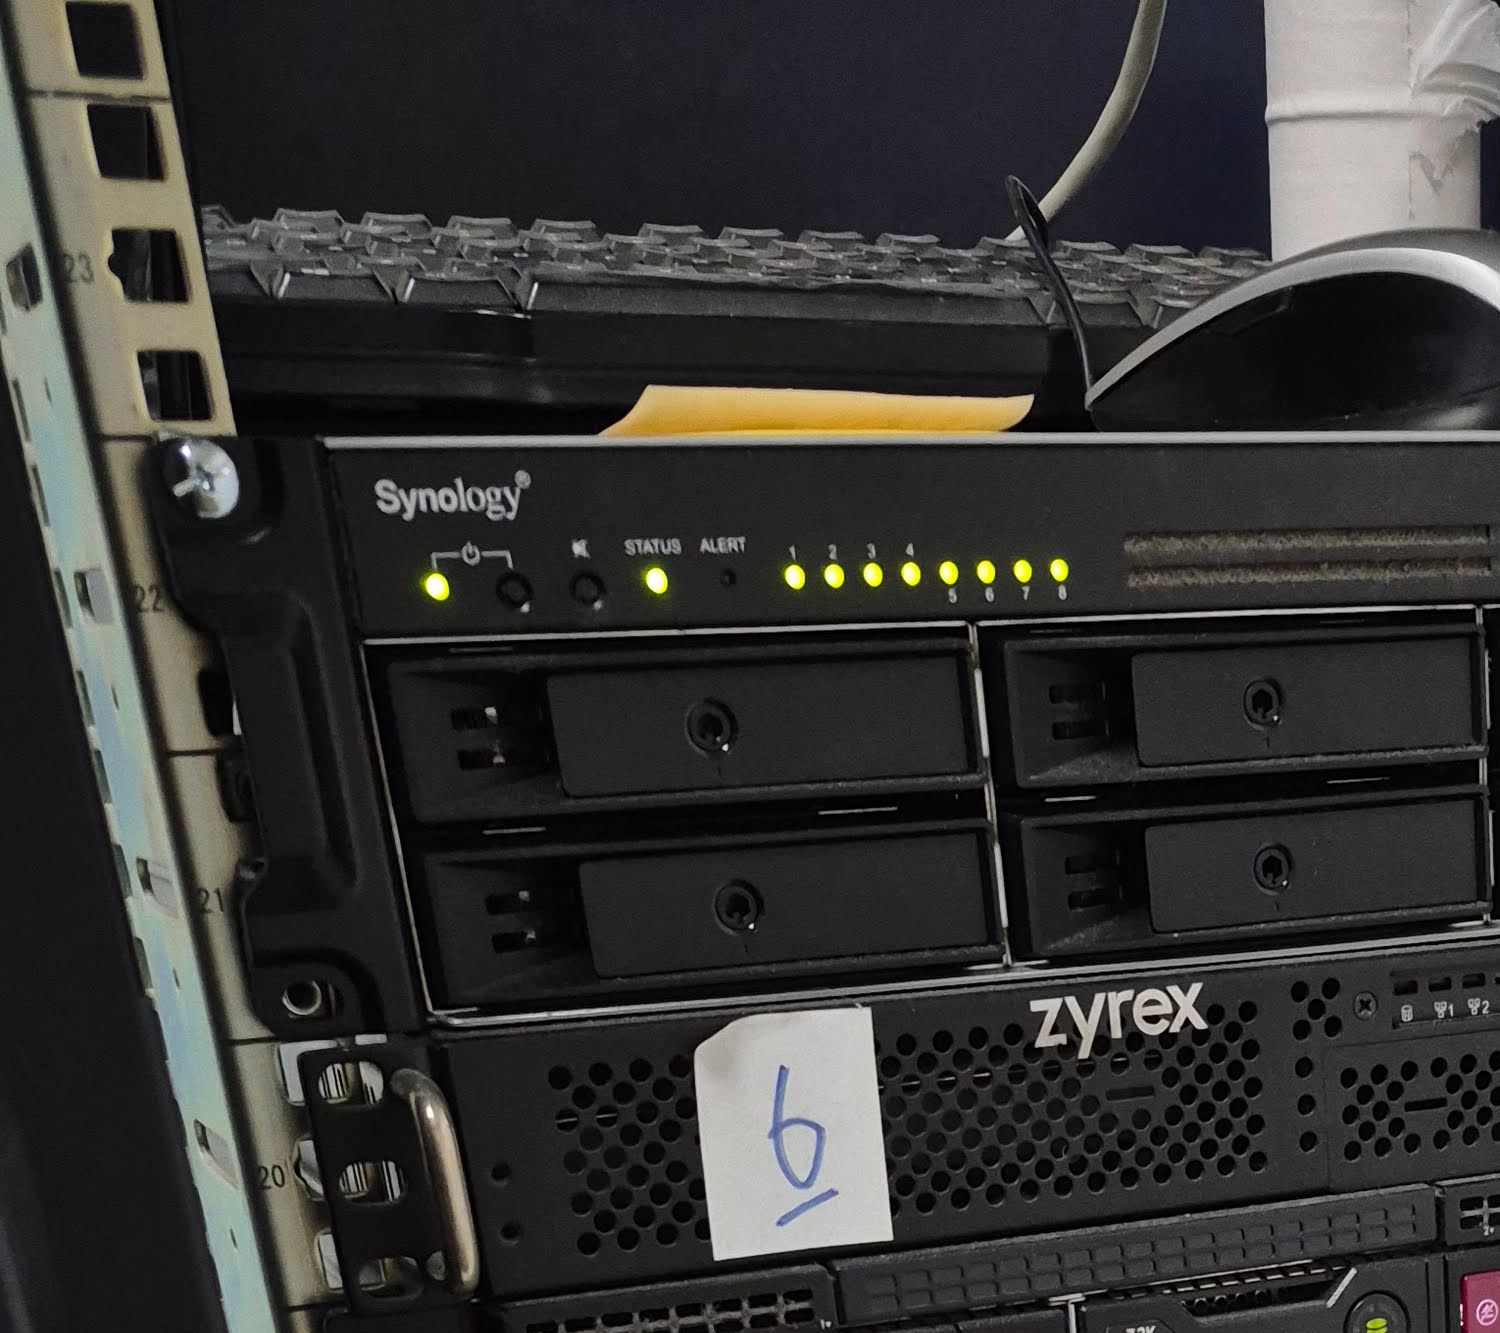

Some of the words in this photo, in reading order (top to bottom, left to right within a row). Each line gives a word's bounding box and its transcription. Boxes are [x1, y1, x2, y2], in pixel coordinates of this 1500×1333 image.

[374, 476, 523, 521] Synology
[624, 536, 682, 556] STATUS
[699, 535, 747, 554] ALERT
[789, 544, 797, 561] 1
[828, 543, 838, 561] 2
[866, 542, 877, 560] 3
[1020, 585, 1030, 601] 7
[1057, 584, 1068, 601] 8
[1029, 981, 1209, 1060] zyrex
[767, 1064, 827, 1190] 6
[259, 1164, 286, 1191] 20
